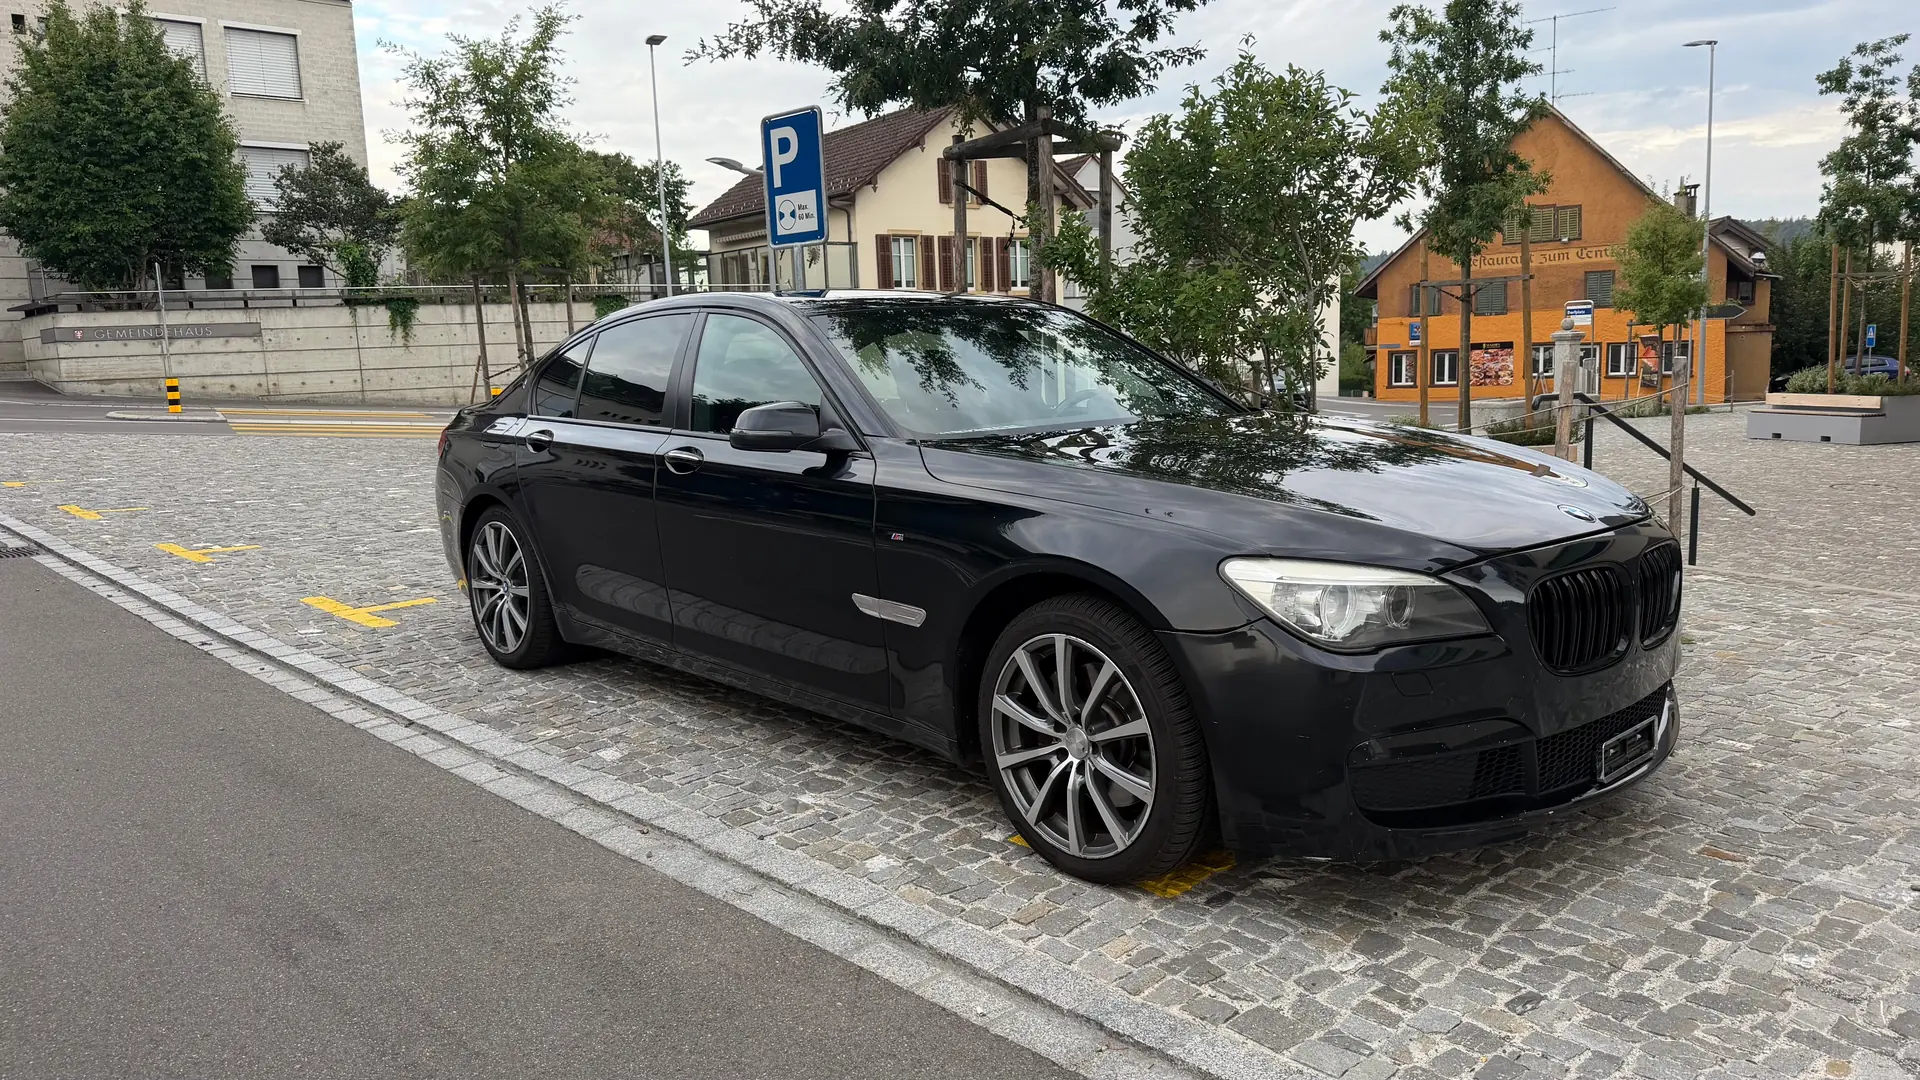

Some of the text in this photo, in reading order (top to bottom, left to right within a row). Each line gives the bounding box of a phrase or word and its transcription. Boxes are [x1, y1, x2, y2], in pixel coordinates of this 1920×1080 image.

[770, 126, 798, 188] P
[1538, 252, 1570, 265] zum
[94, 327, 213, 339] GEMEINDEHAUS
